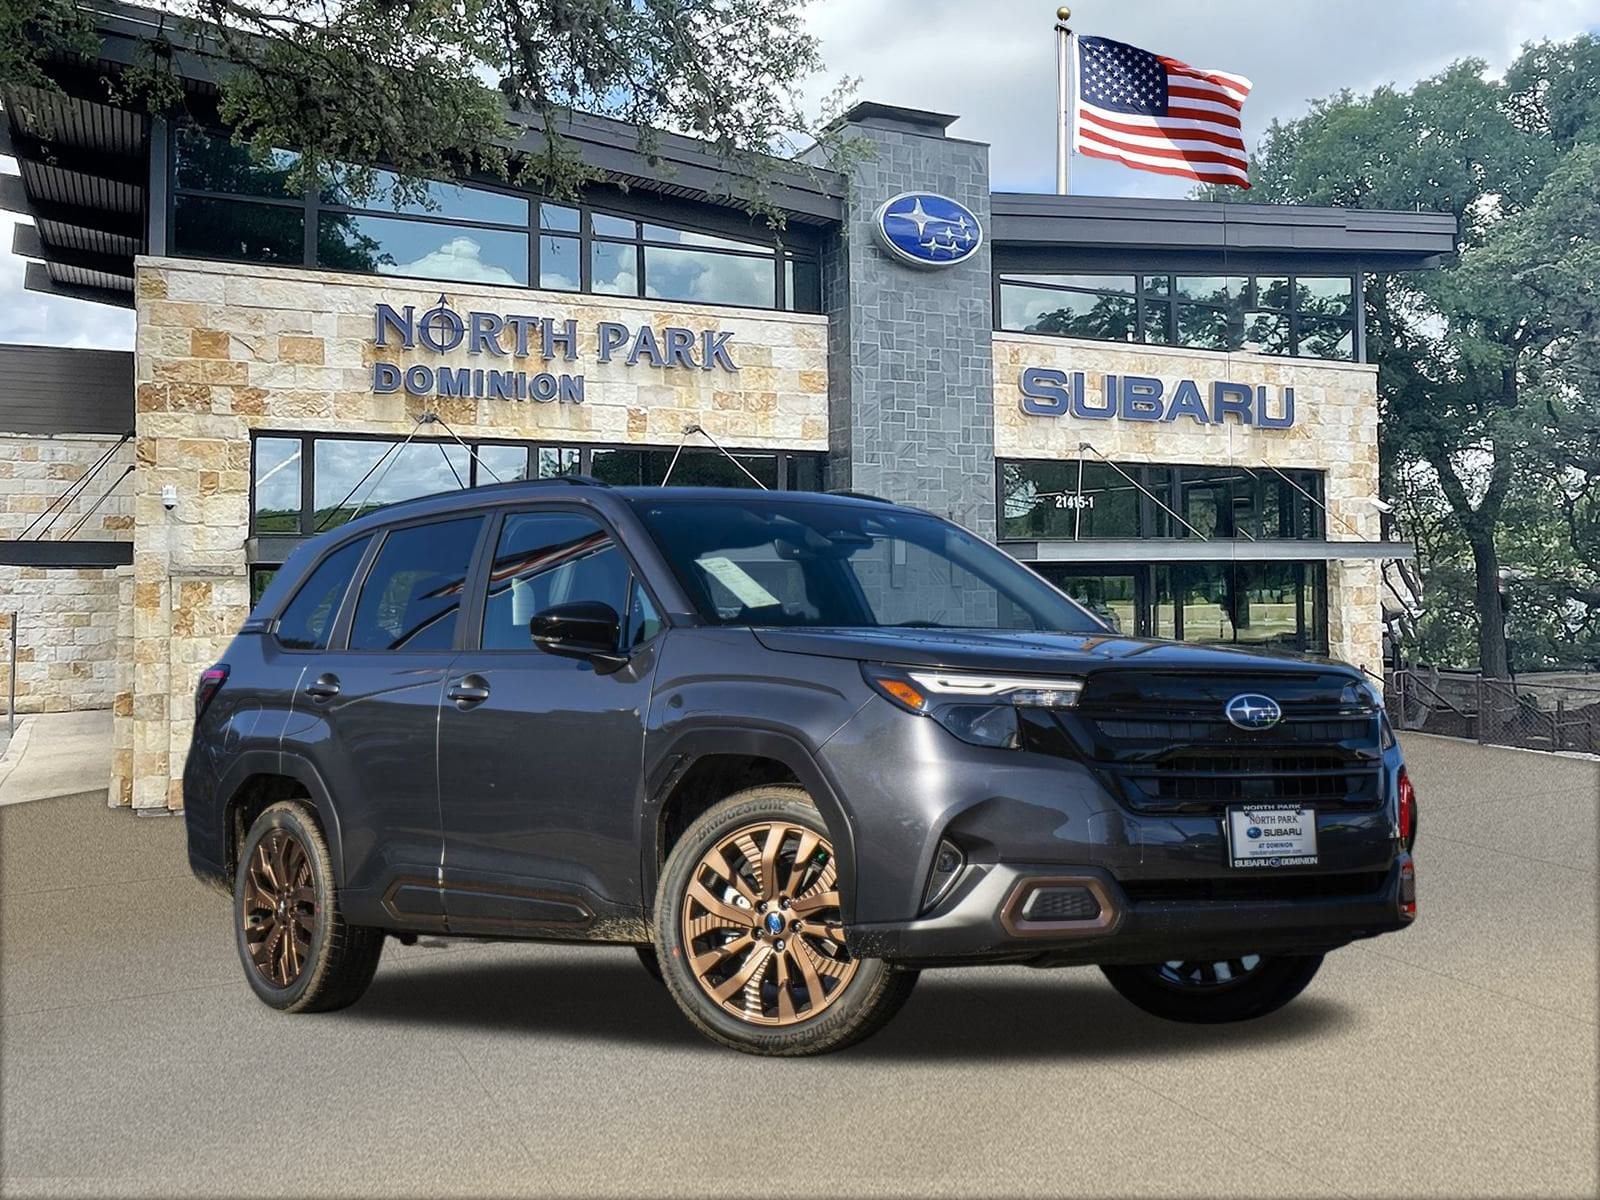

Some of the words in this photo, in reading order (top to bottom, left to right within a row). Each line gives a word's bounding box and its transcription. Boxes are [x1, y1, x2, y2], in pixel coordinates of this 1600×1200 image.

[374, 299, 579, 361] NORTH
[597, 321, 742, 373] PARK
[371, 361, 586, 404] DOMINION
[1018, 366, 1296, 430] SUBARU
[1249, 815, 1275, 824] NORTH
[1278, 815, 1299, 824] PARK
[1263, 827, 1302, 837] SUBARU
[1234, 858, 1269, 868] SUBARU
[1281, 857, 1318, 866] DOMINION
